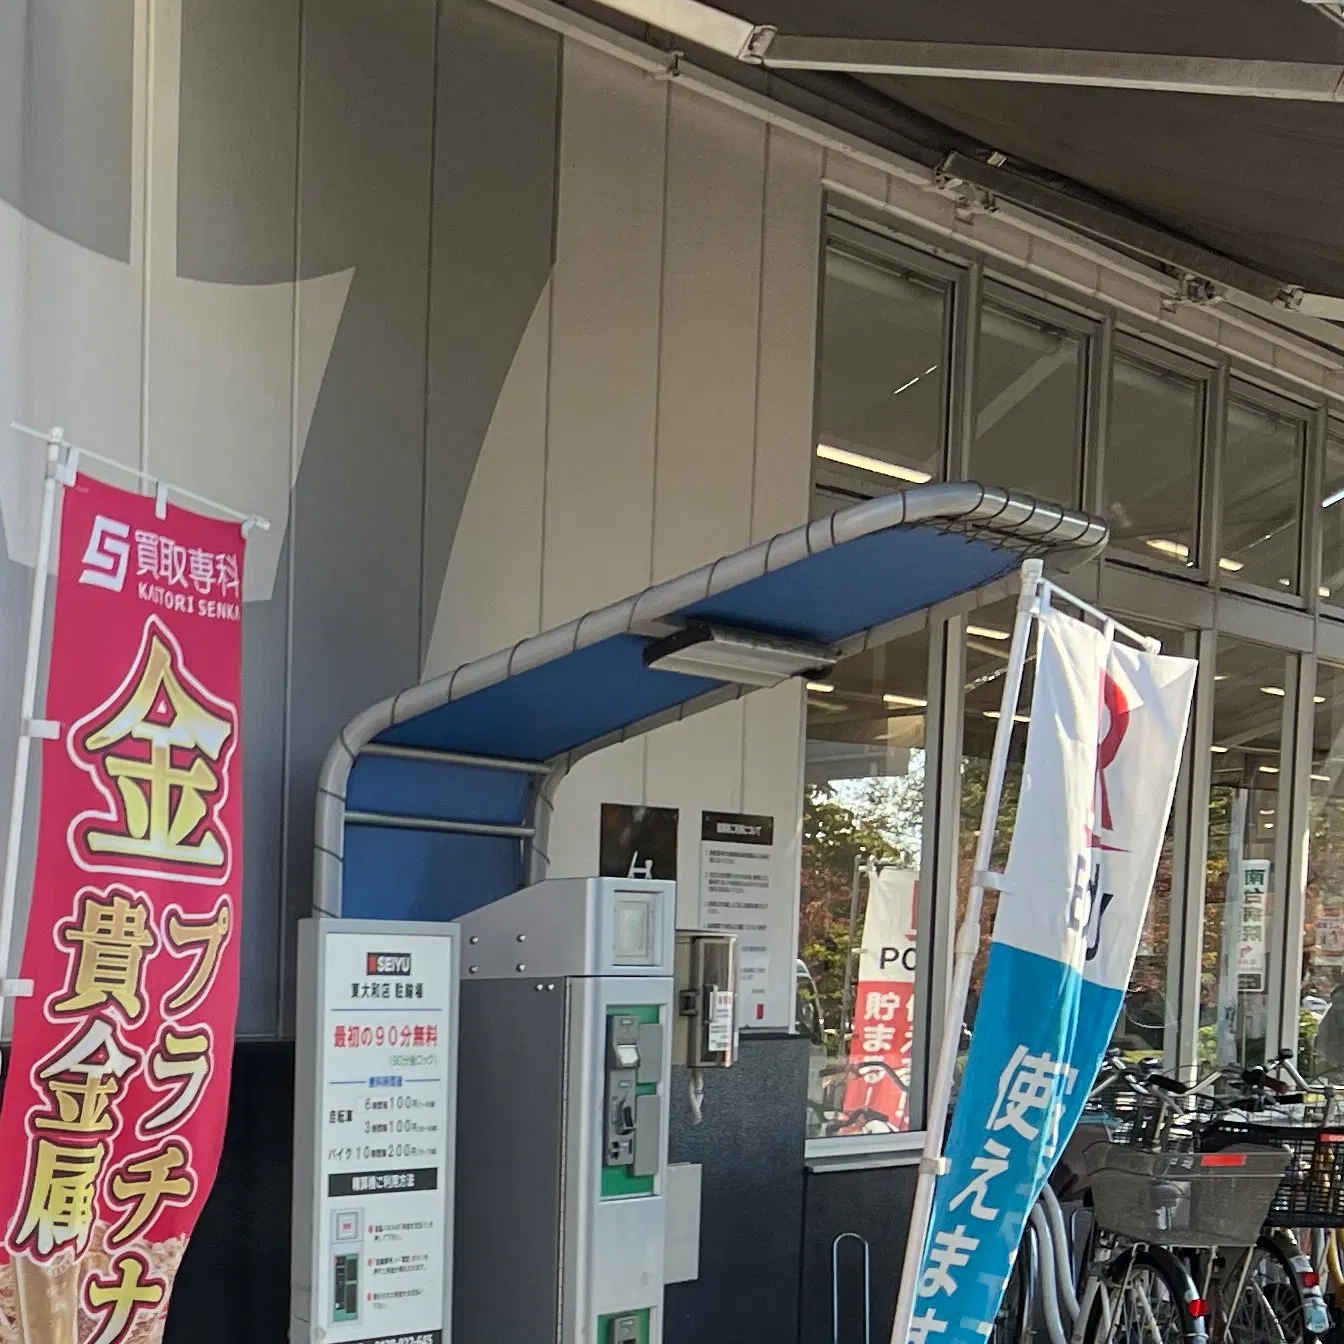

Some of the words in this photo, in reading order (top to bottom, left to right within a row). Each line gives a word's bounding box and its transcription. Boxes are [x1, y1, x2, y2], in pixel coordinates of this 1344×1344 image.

[134, 529, 241, 600] 買取専科
[138, 581, 196, 614] KAITORI
[78, 625, 234, 874] 金
[376, 955, 411, 973] SEIYU
[12, 893, 156, 1256] 貴金属
